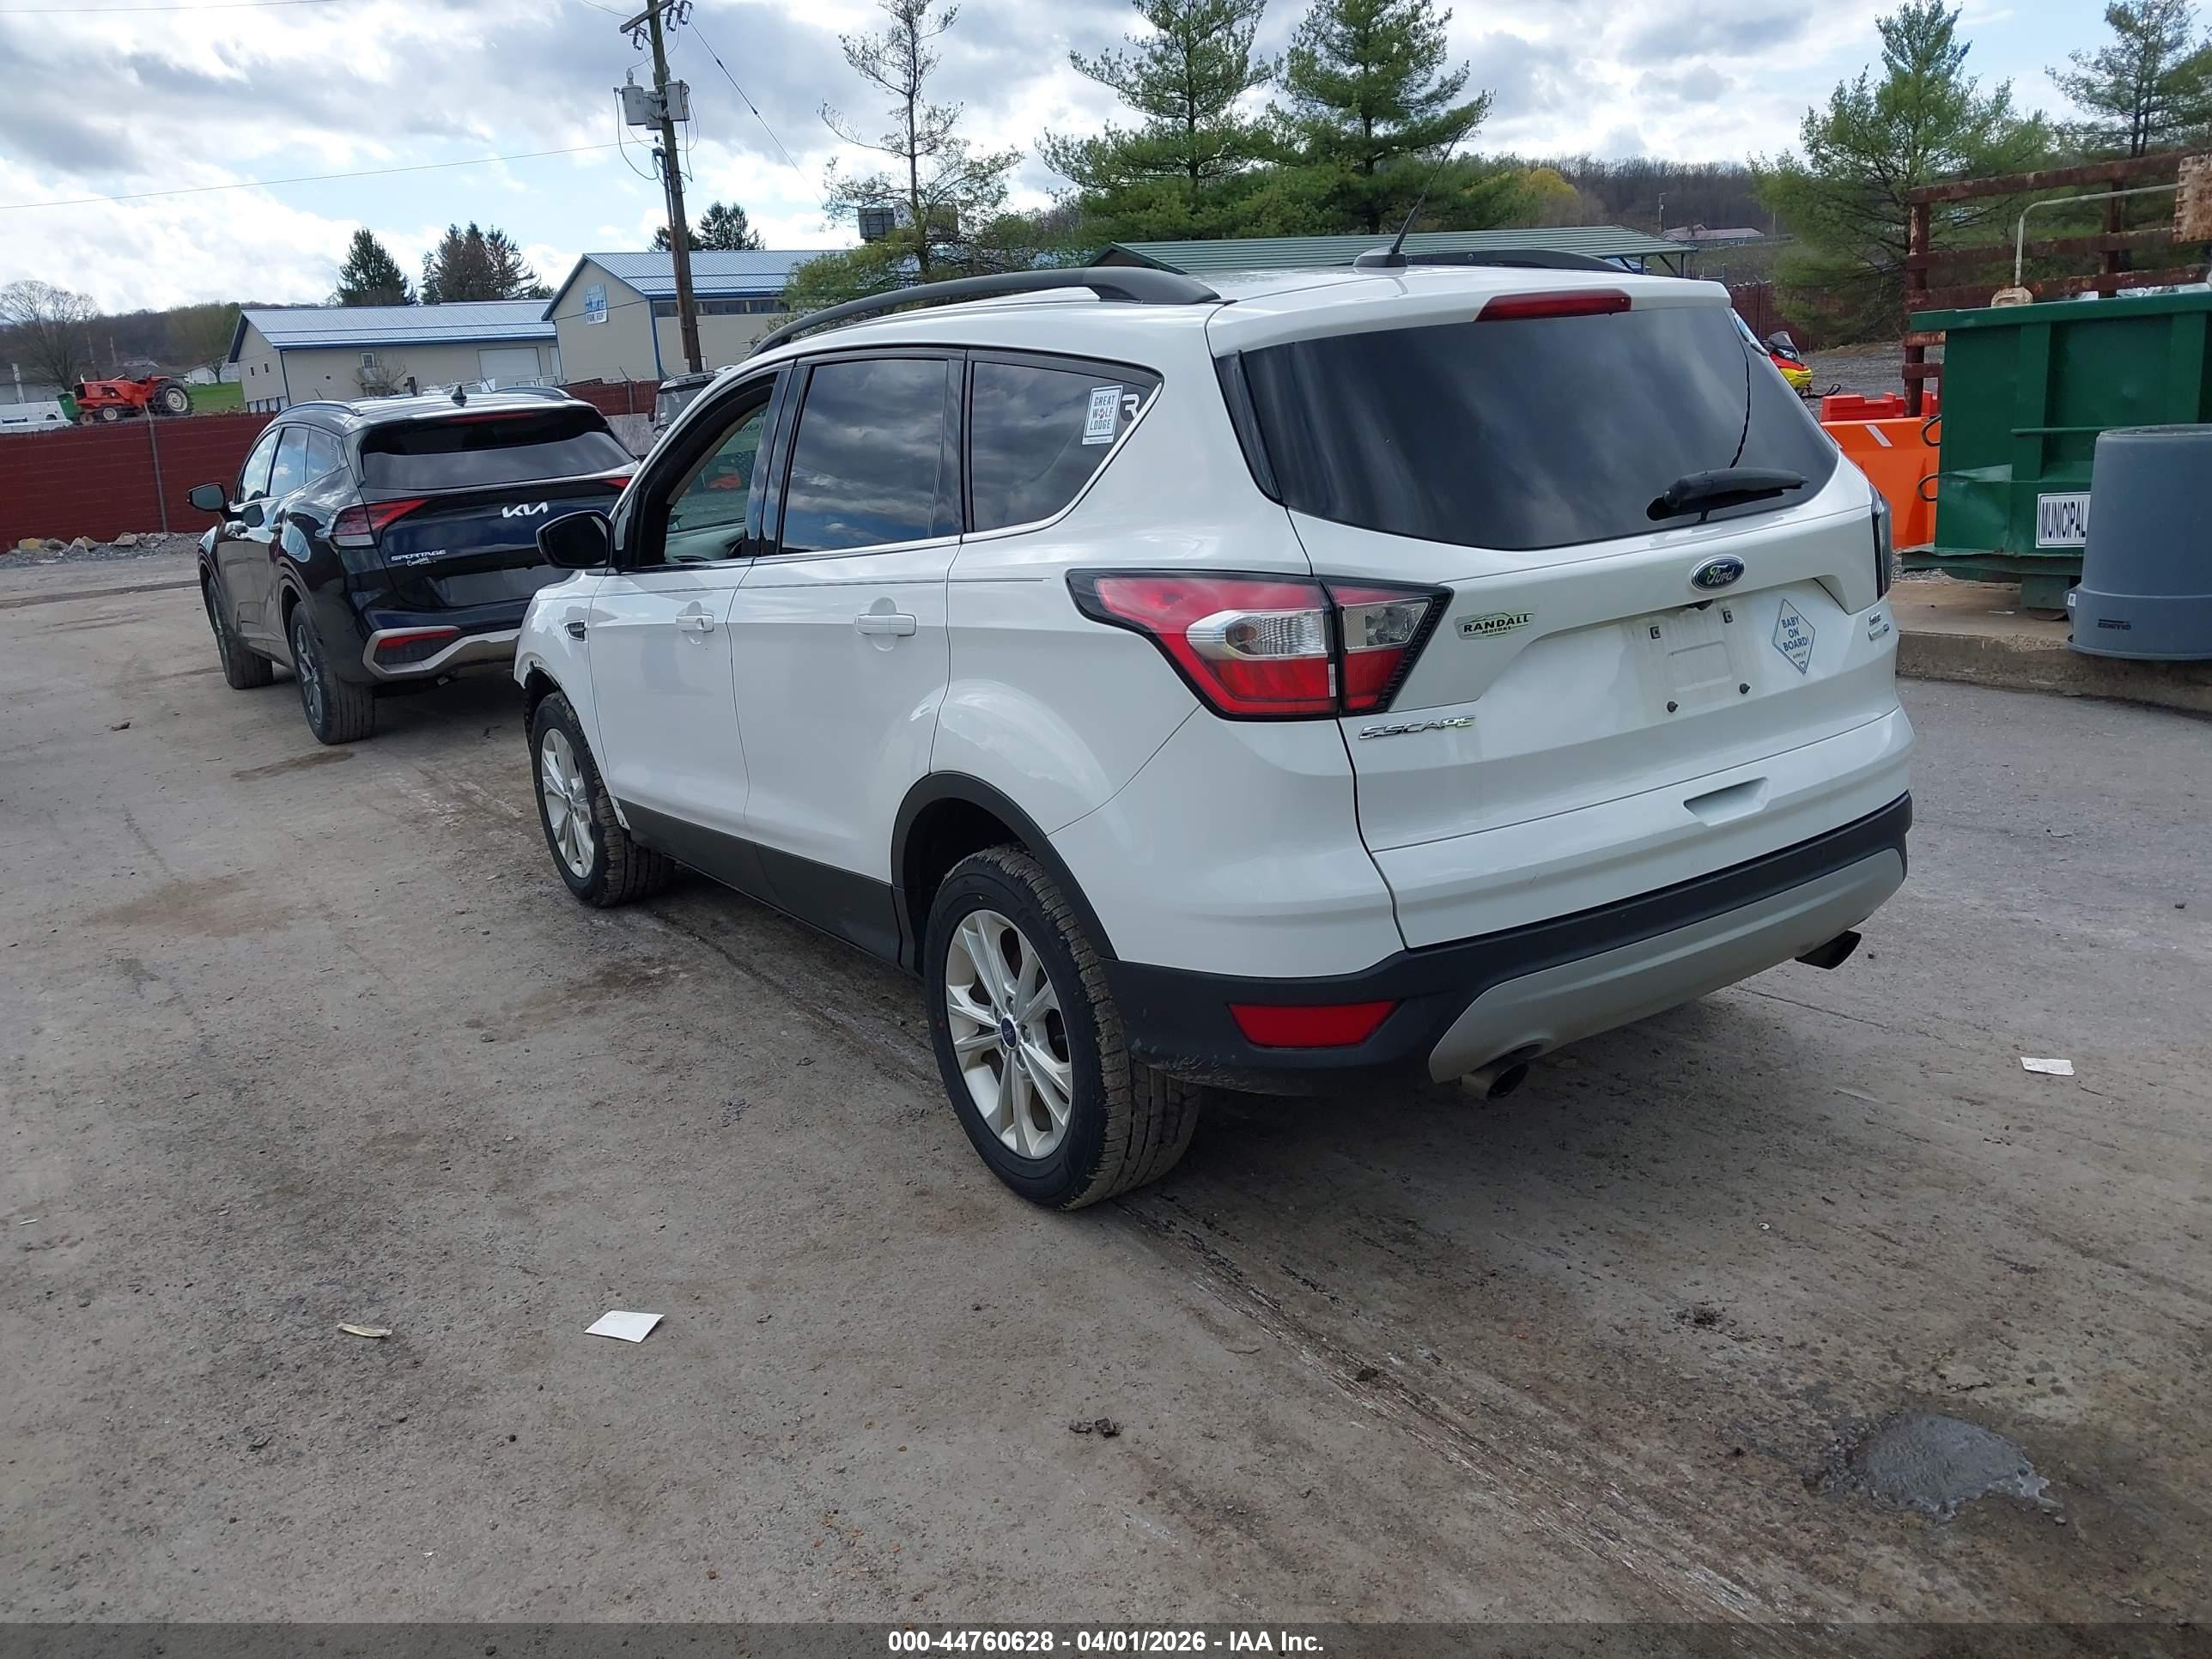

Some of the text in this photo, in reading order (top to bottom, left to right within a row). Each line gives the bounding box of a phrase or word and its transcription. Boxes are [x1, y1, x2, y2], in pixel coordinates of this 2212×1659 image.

[1093, 395, 1115, 407] GREAT
[1090, 418, 1111, 430] LODGE
[501, 501, 549, 518] KIA
[2041, 501, 2086, 539] MUNICIPAL
[391, 550, 447, 562] SPORTAGE
[1706, 564, 1735, 585] Ford
[1464, 614, 1529, 633] RANDALL
[1782, 616, 1799, 629] BABY
[1482, 626, 1511, 635] MOTORS
[1789, 627, 1800, 638] ON
[1783, 635, 1809, 652] BOARD!
[1358, 715, 1476, 739] ESCAPE
